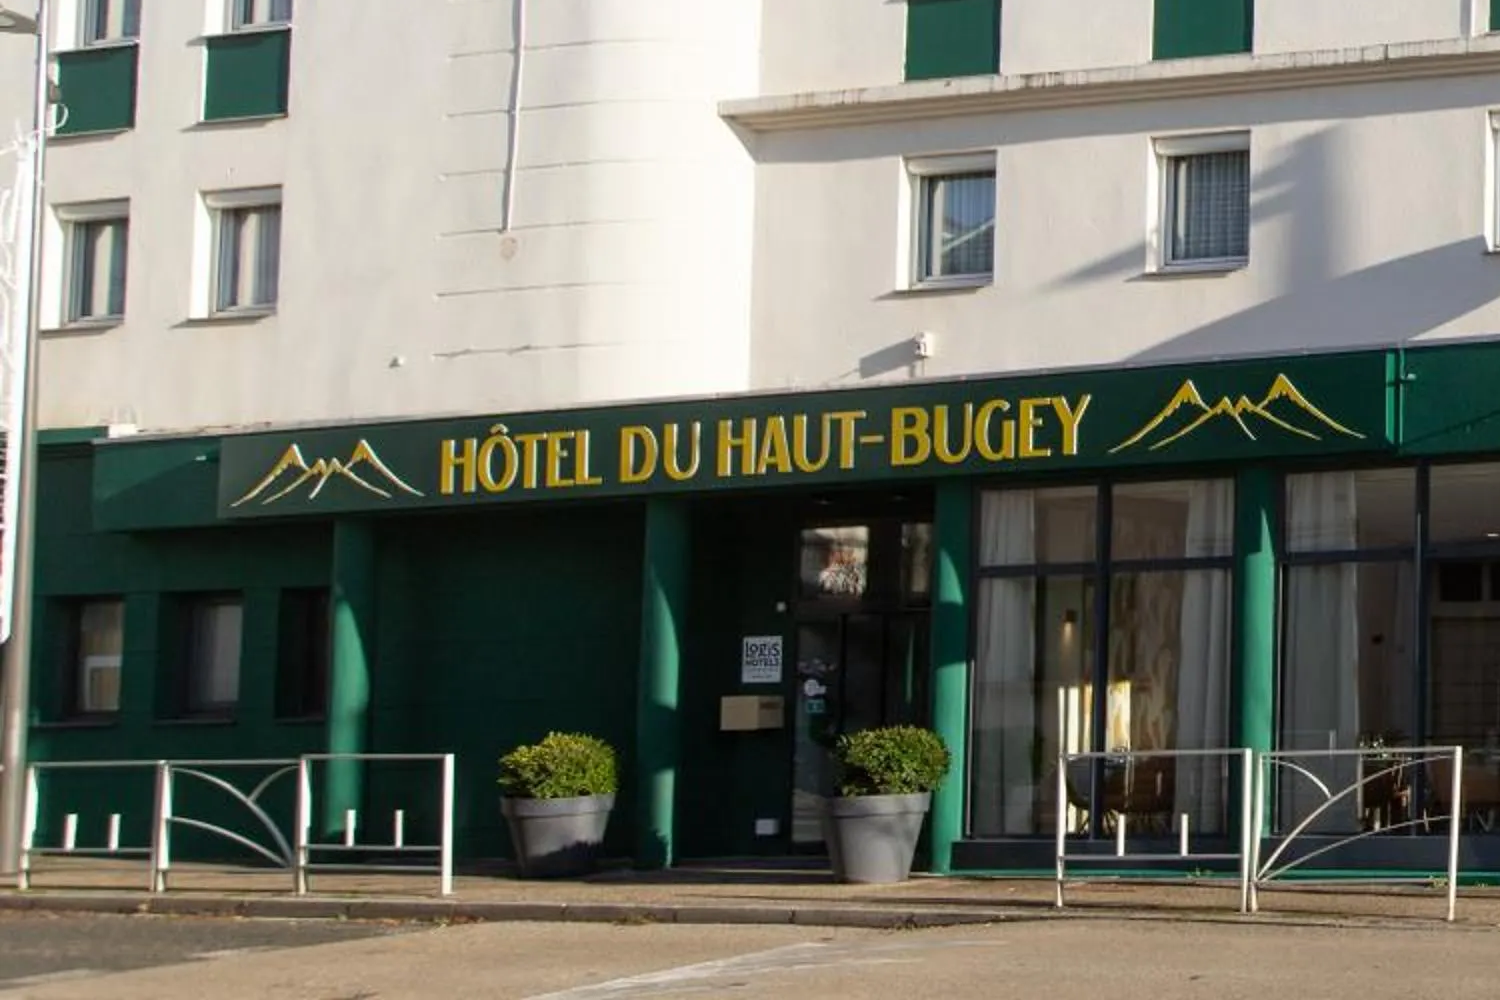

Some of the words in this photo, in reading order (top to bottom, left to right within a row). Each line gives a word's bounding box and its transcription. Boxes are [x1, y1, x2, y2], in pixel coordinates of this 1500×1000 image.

[440, 422, 603, 495] HÔTEL
[619, 421, 701, 484] DU
[716, 393, 1092, 478] HAUT-BUGEY
